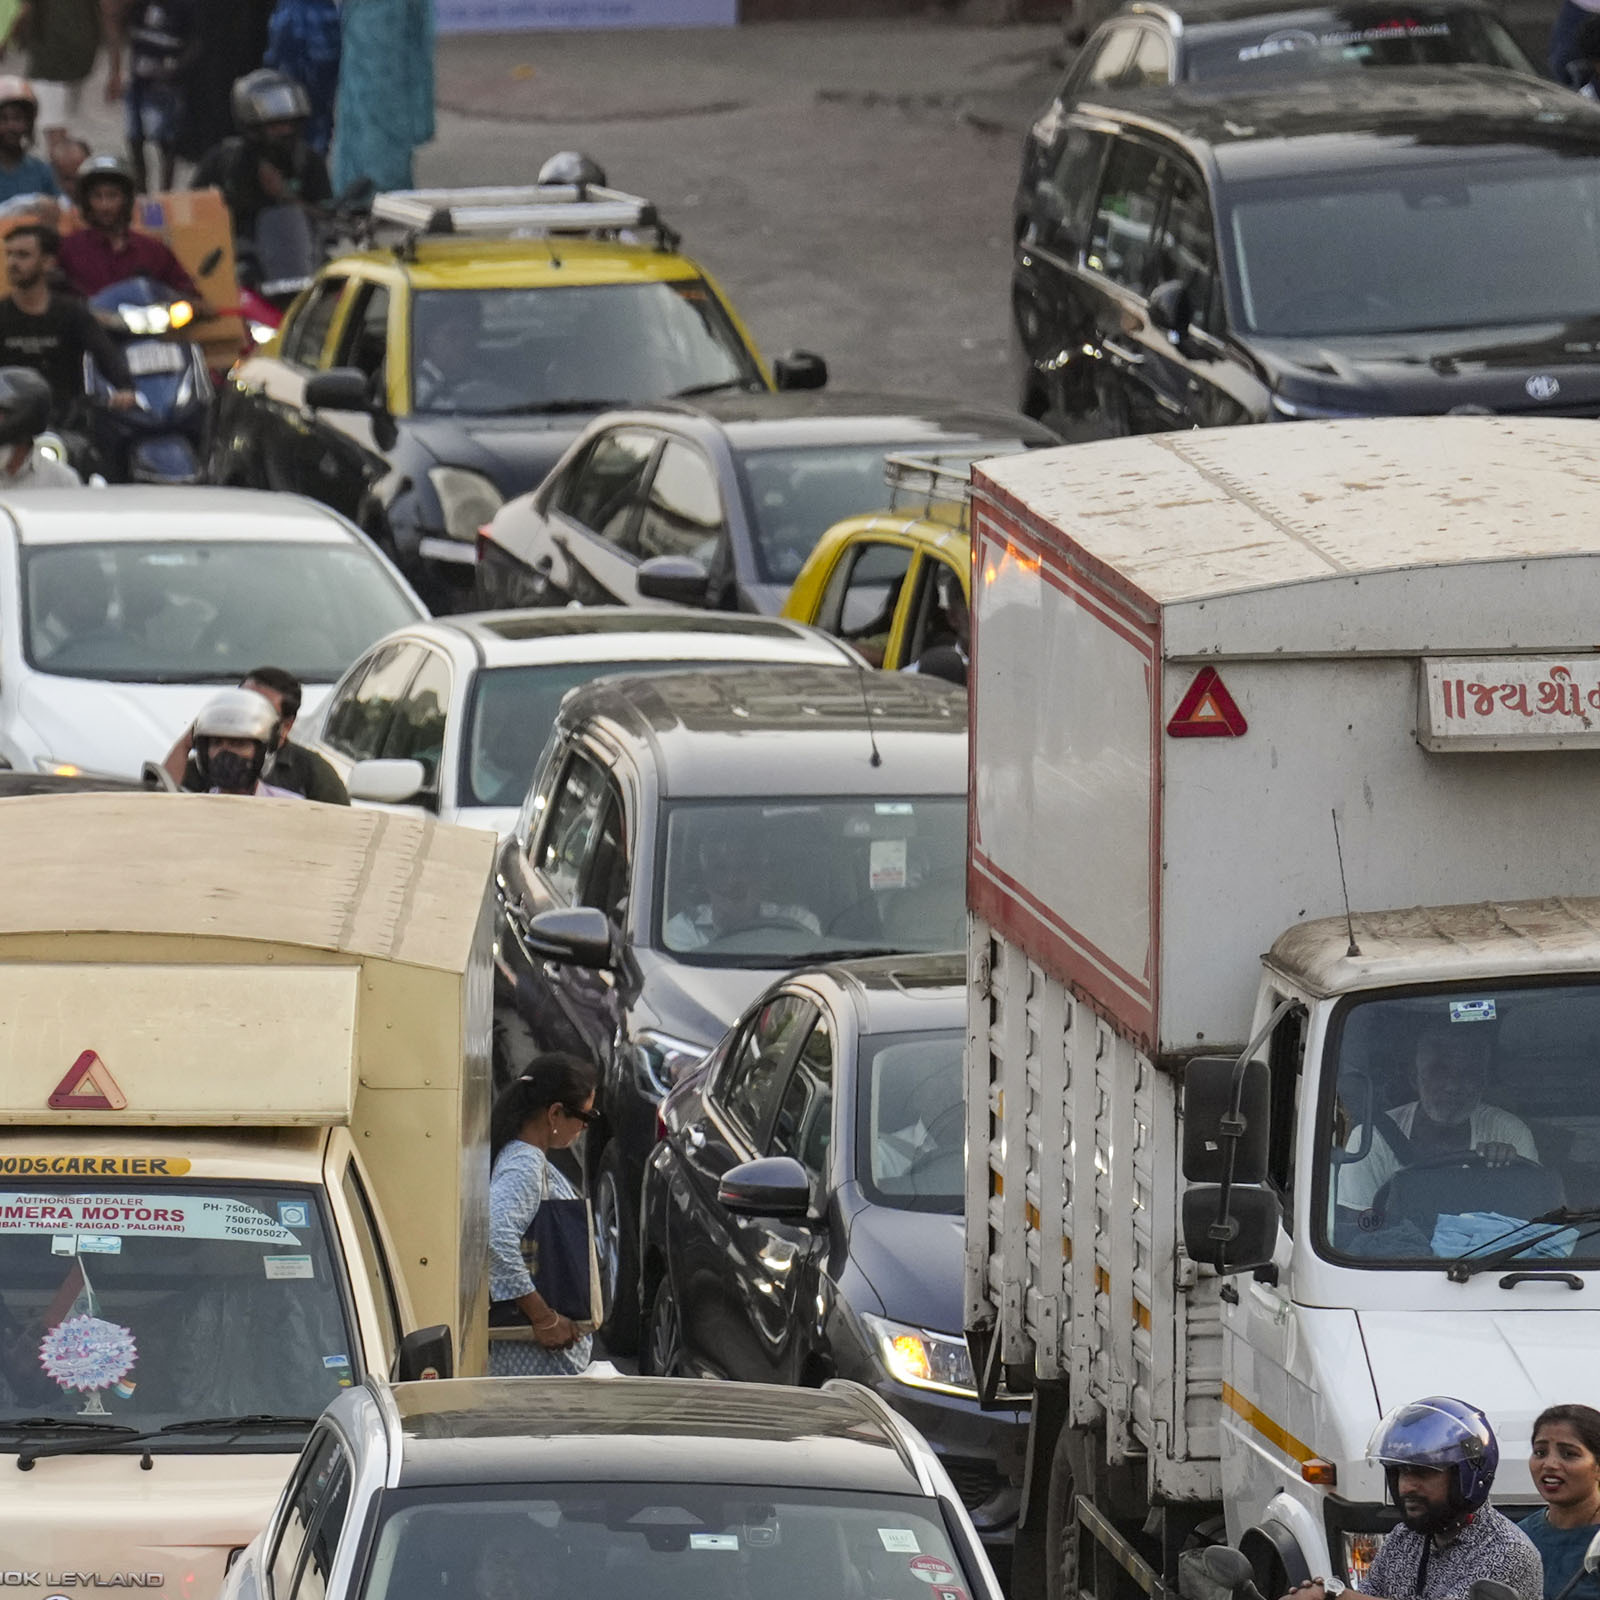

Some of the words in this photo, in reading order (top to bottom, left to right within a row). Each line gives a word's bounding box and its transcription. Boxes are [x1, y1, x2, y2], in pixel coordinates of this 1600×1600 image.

[16, 1197, 92, 1205] AUTHORISED
[96, 1198, 144, 1206] DEALER
[82, 1208, 185, 1221] MOTORS
[225, 1226, 288, 1238] 7506705027
[47, 1572, 165, 1588] LEYLAND
